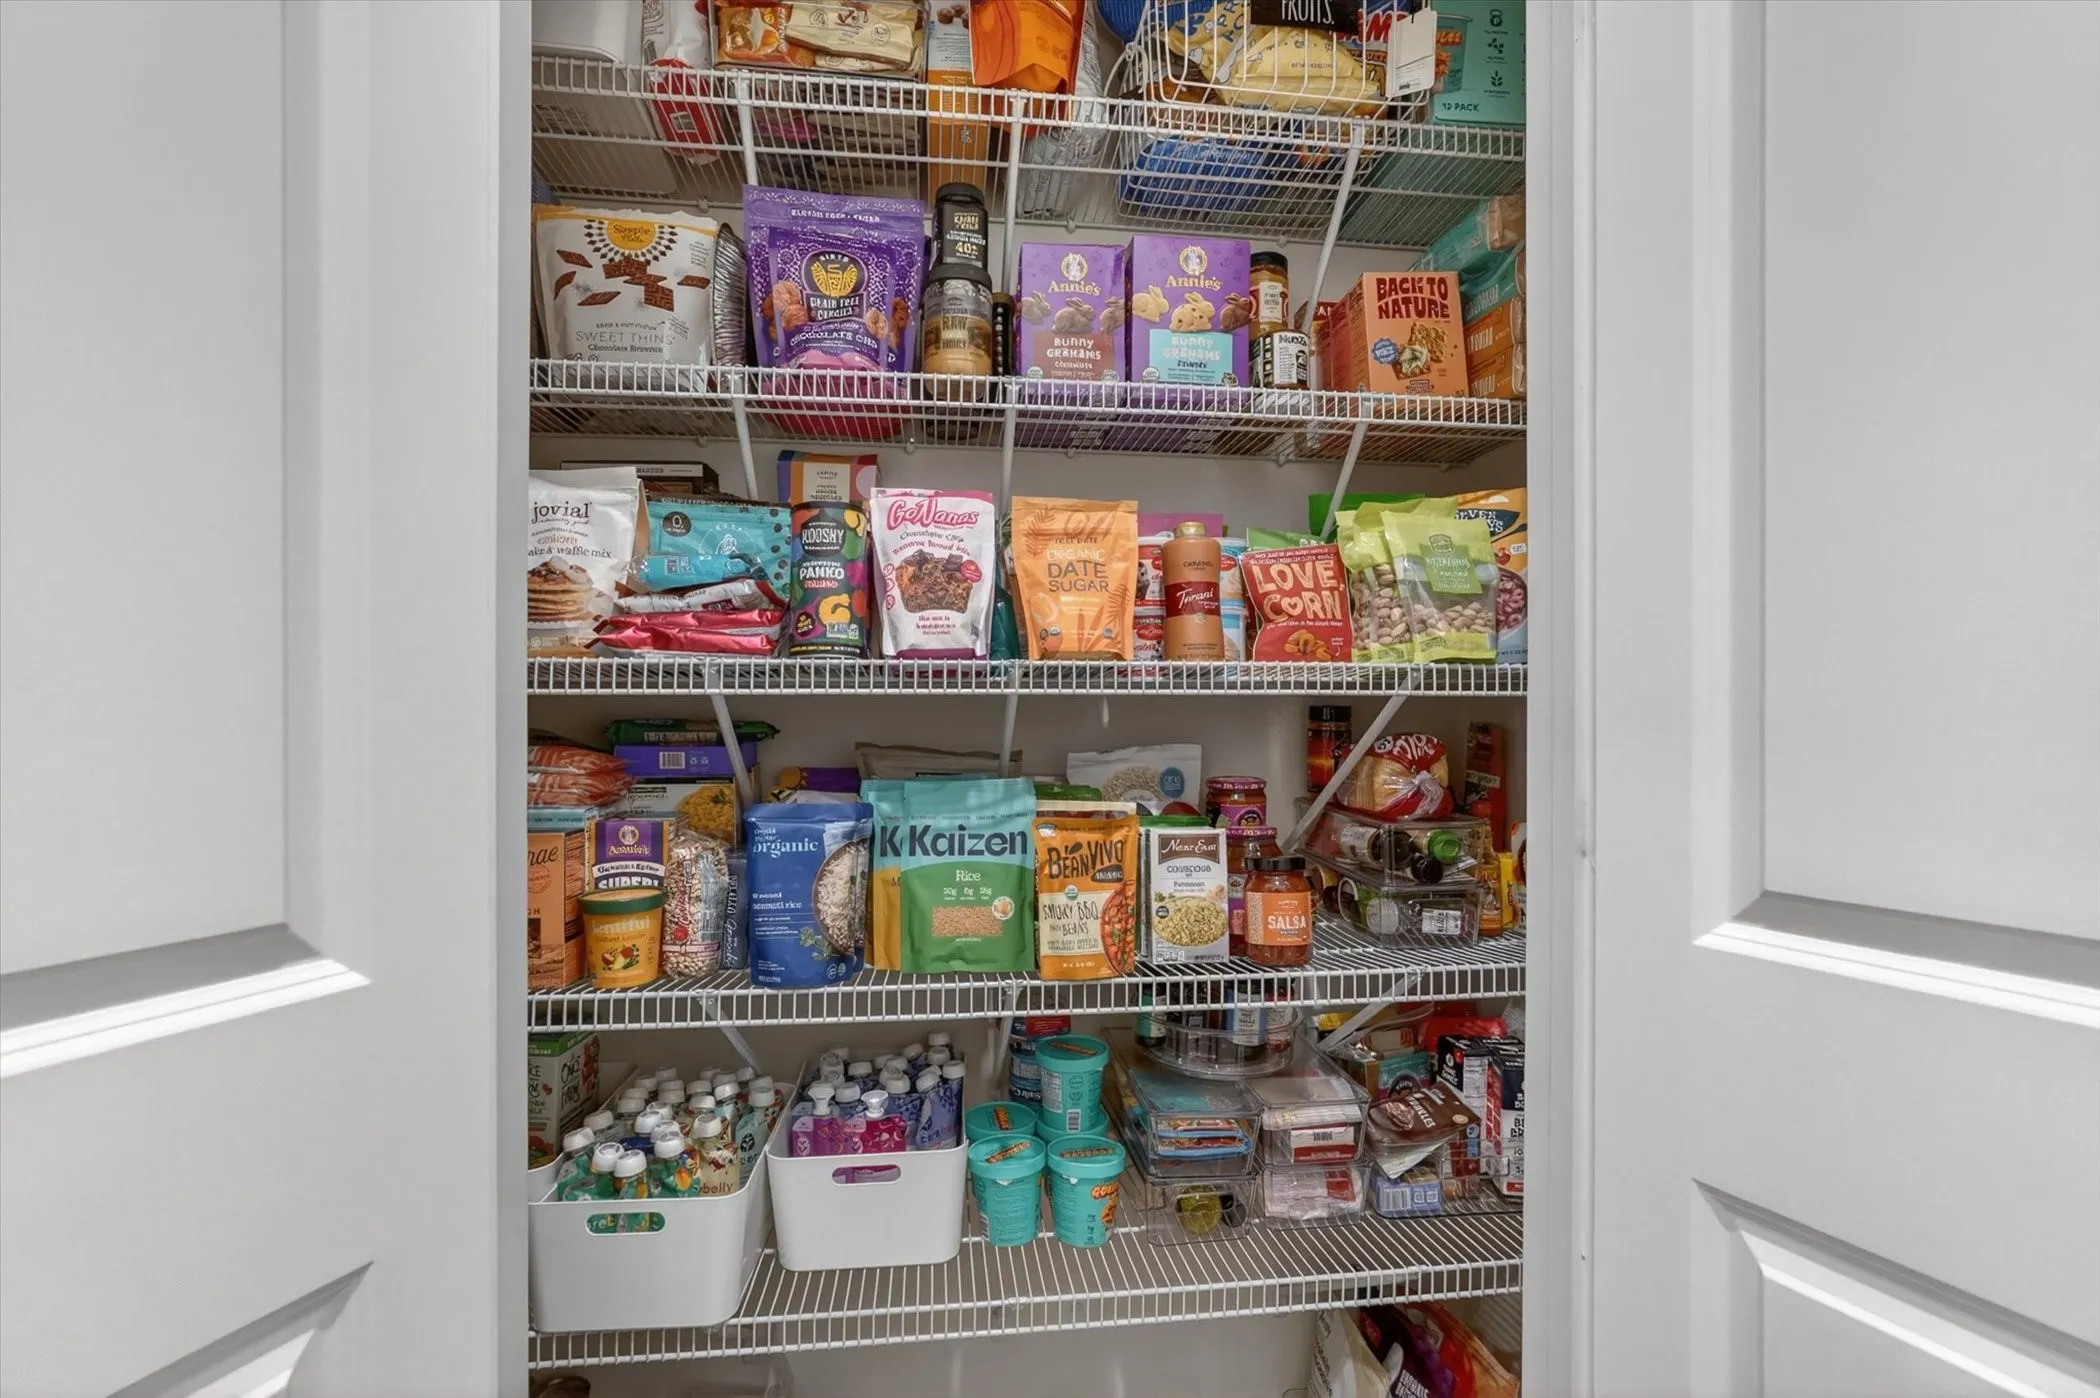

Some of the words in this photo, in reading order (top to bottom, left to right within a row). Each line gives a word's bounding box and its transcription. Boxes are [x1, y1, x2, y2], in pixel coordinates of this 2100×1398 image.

[1454, 103, 1480, 112] PACK
[1048, 280, 1101, 296] Annie's
[1166, 275, 1223, 291] Annie's
[1425, 276, 1449, 297] TO
[1378, 297, 1450, 320] NATURE
[575, 330, 625, 343] SWEET
[531, 501, 590, 524] jovial
[887, 498, 979, 531] GoNanas
[557, 546, 590, 556] waffle
[591, 548, 612, 559] mix
[799, 567, 846, 580] PANKO
[1048, 559, 1109, 579] DATE
[1251, 560, 1339, 594] LOVE
[1048, 578, 1110, 593] SUGAR
[908, 823, 1028, 857] Kaizen
[753, 838, 819, 859] organic
[955, 869, 981, 882] Rice
[1267, 915, 1307, 930] SALSA
